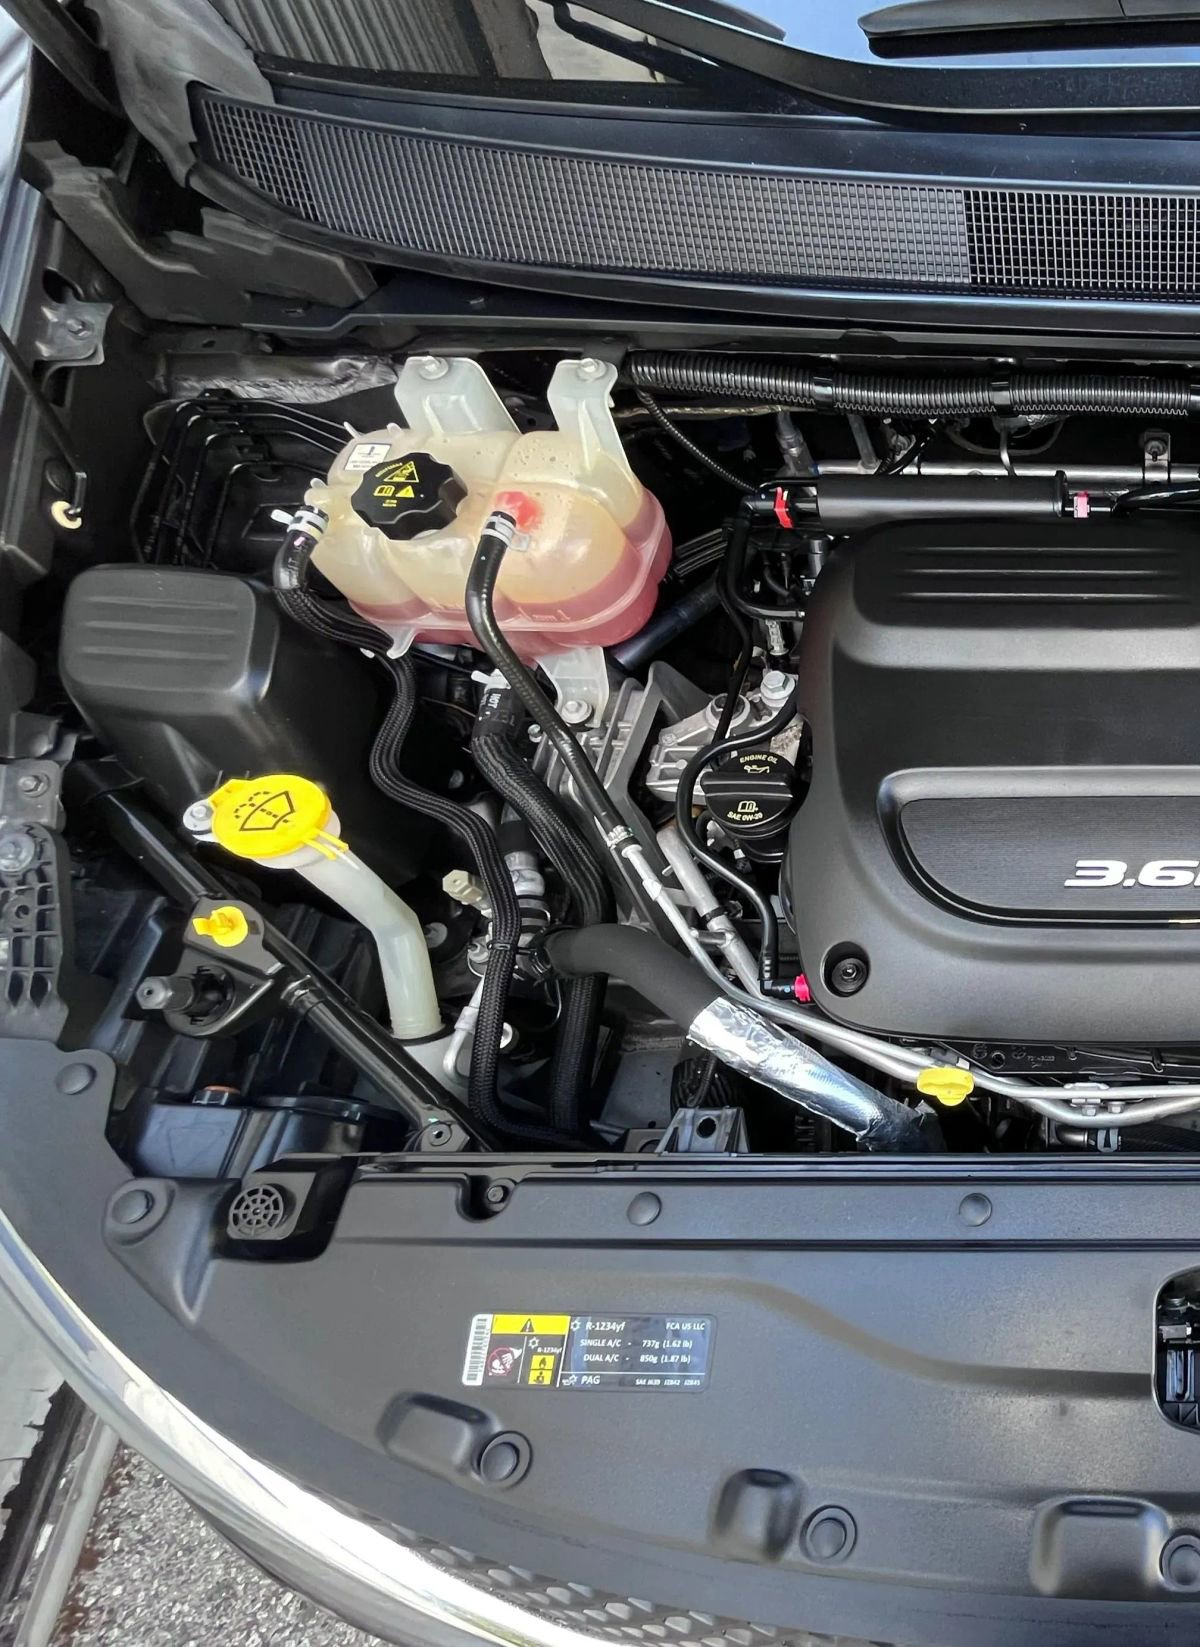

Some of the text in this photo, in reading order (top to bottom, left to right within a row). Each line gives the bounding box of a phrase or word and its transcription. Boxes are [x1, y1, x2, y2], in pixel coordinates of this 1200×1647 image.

[740, 754, 778, 764] ENGINE OIL
[727, 811, 742, 820] SAE
[585, 1321, 705, 1332] R-1234yf FCA US LLC
[580, 1339, 606, 1347] SINGLE
[607, 1339, 622, 1348] A/C
[642, 1340, 660, 1349] 737g
[583, 1354, 603, 1362] DUAL
[604, 1354, 619, 1363] A/C
[640, 1355, 658, 1364] 850g
[581, 1375, 600, 1385] PAG
